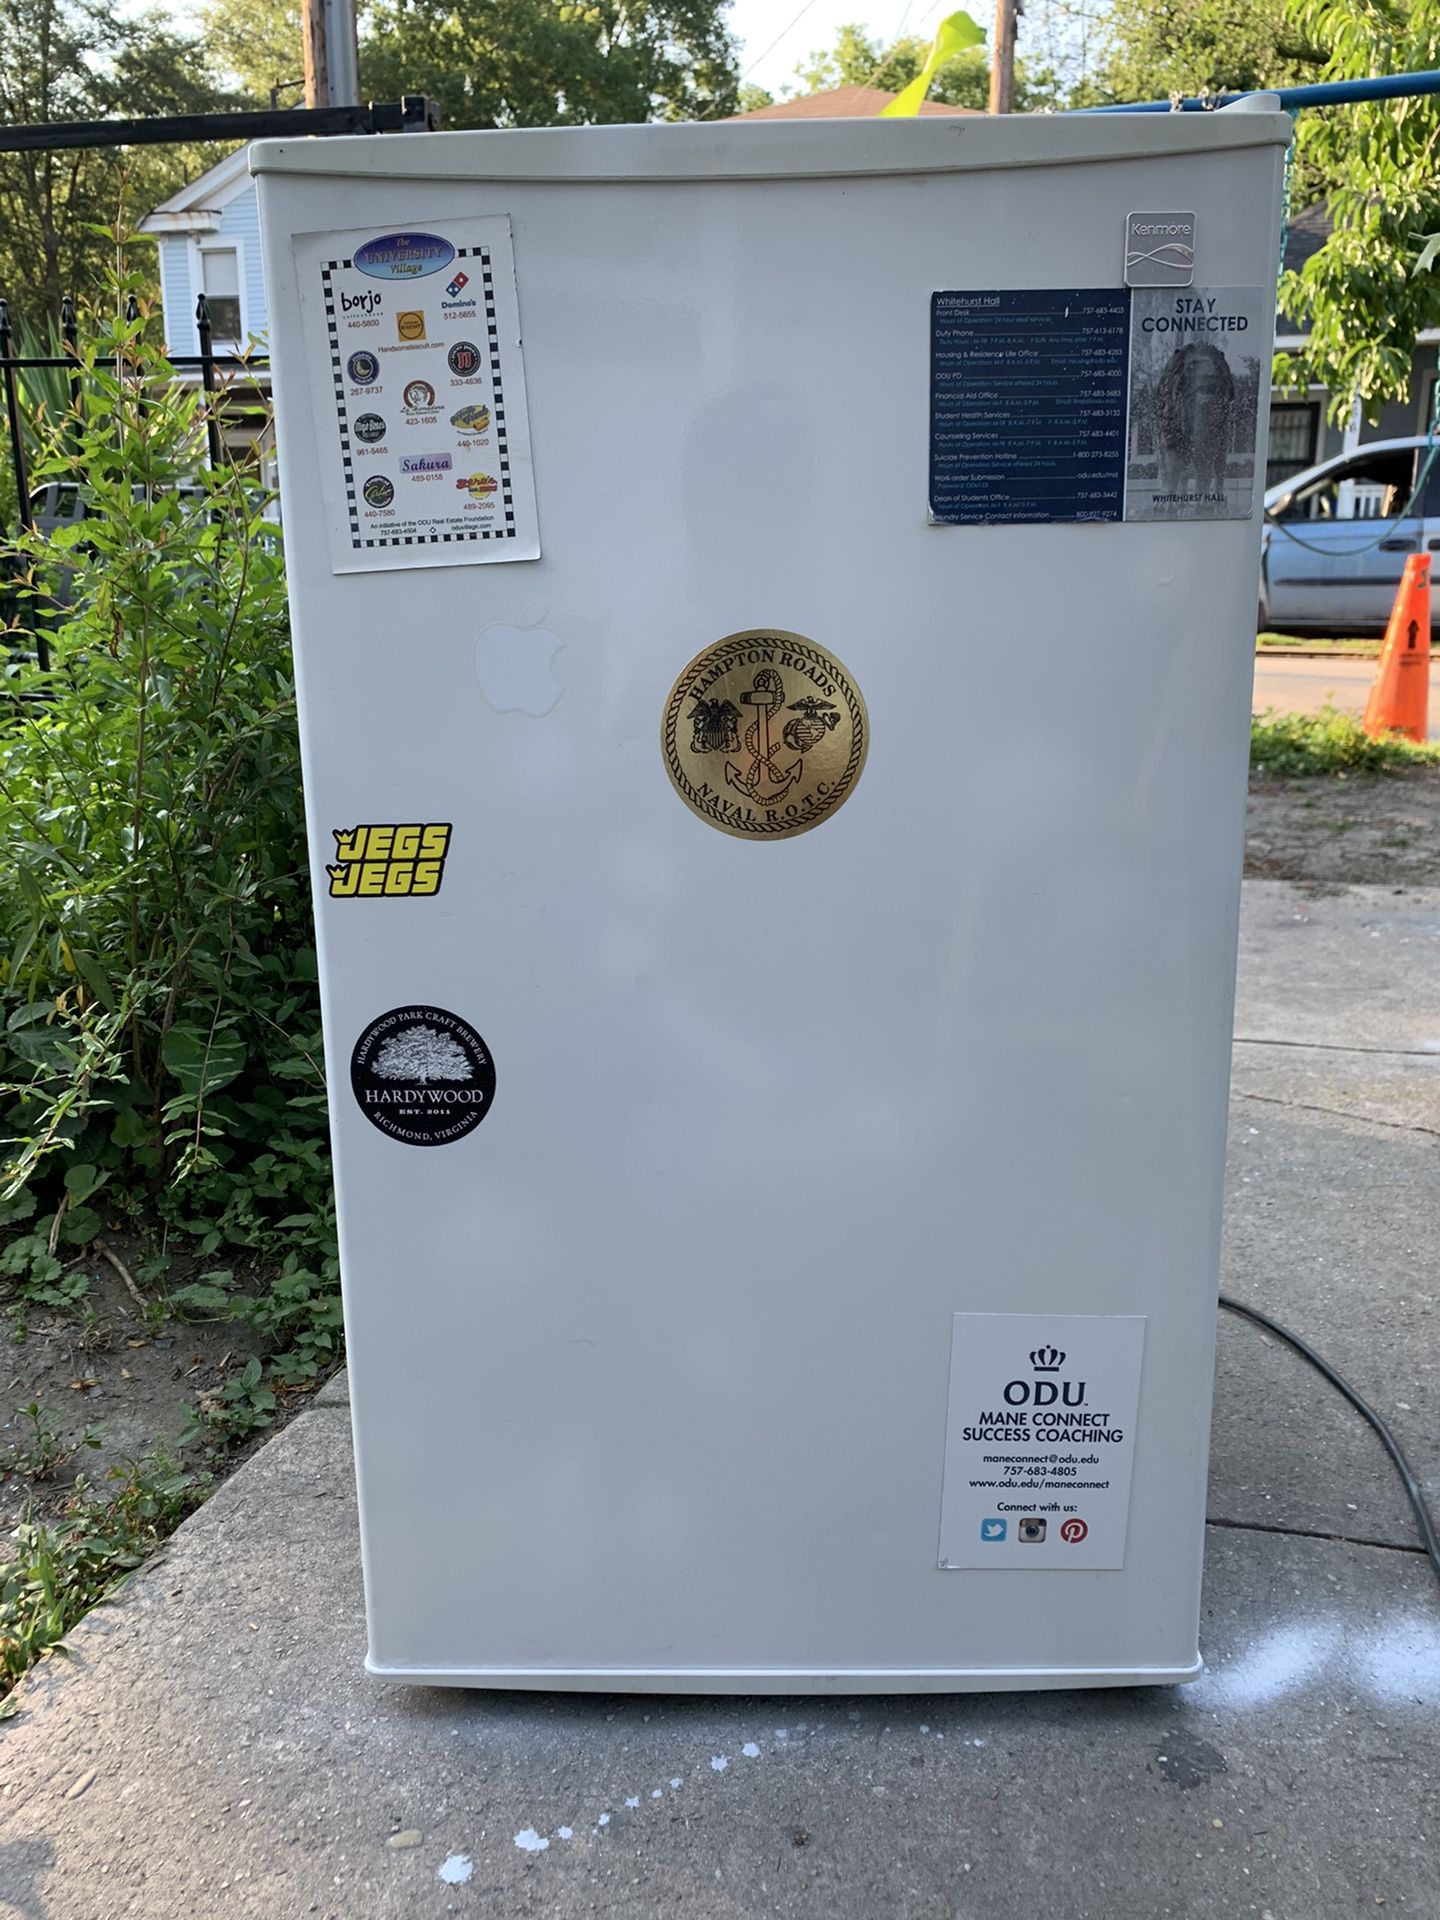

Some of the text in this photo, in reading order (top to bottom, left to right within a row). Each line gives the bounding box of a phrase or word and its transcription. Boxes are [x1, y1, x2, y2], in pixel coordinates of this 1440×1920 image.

[1131, 223, 1191, 236] Kenmore
[396, 238, 410, 247] The
[364, 246, 443, 264] UNIVERSITY
[390, 263, 422, 274] Village
[340, 290, 382, 313] borjo
[441, 299, 476, 309] Domino's
[936, 297, 1000, 306] Whitehurst Hall
[1175, 299, 1216, 313] STAY
[443, 311, 476, 320] 512-5655
[347, 319, 379, 329] 440-5800
[1142, 316, 1248, 332] CONNECTED
[378, 341, 444, 353] Handsomebiscuit.com
[935, 352, 962, 360] Housing
[450, 378, 483, 387] 333-4636
[350, 386, 383, 396] 267-9737
[405, 417, 438, 426] 423-1605
[457, 438, 489, 448] 440-1020
[356, 447, 388, 456] 961-5465
[402, 458, 450, 472] Sakura
[1152, 494, 1225, 502] WHITEHURST HALL
[364, 509, 396, 518] 440-7580
[688, 649, 836, 702] HAMPTON ROADS
[697, 781, 835, 822] NAVAL R.O.T.C.
[337, 824, 450, 861] JEGS
[331, 861, 443, 896] JEGS
[357, 1011, 486, 1065] HARDYWOOD PARK CRAFT BREWERY
[365, 1089, 483, 1103] HARDYWOOD
[373, 1110, 478, 1141] RICHMOND, VIRGINIA
[1003, 1380, 1086, 1407] ODU
[979, 1412, 1110, 1427] MANE CONNECT
[962, 1427, 1124, 1443] SUCCESS COACHING
[983, 1454, 1099, 1465] maneconnect@odu.edu
[1003, 1466, 1077, 1476] 757-683-4805
[969, 1478, 1109, 1490] www.odu.edu/maneconnect
[997, 1502, 1078, 1512] Connect with us:
